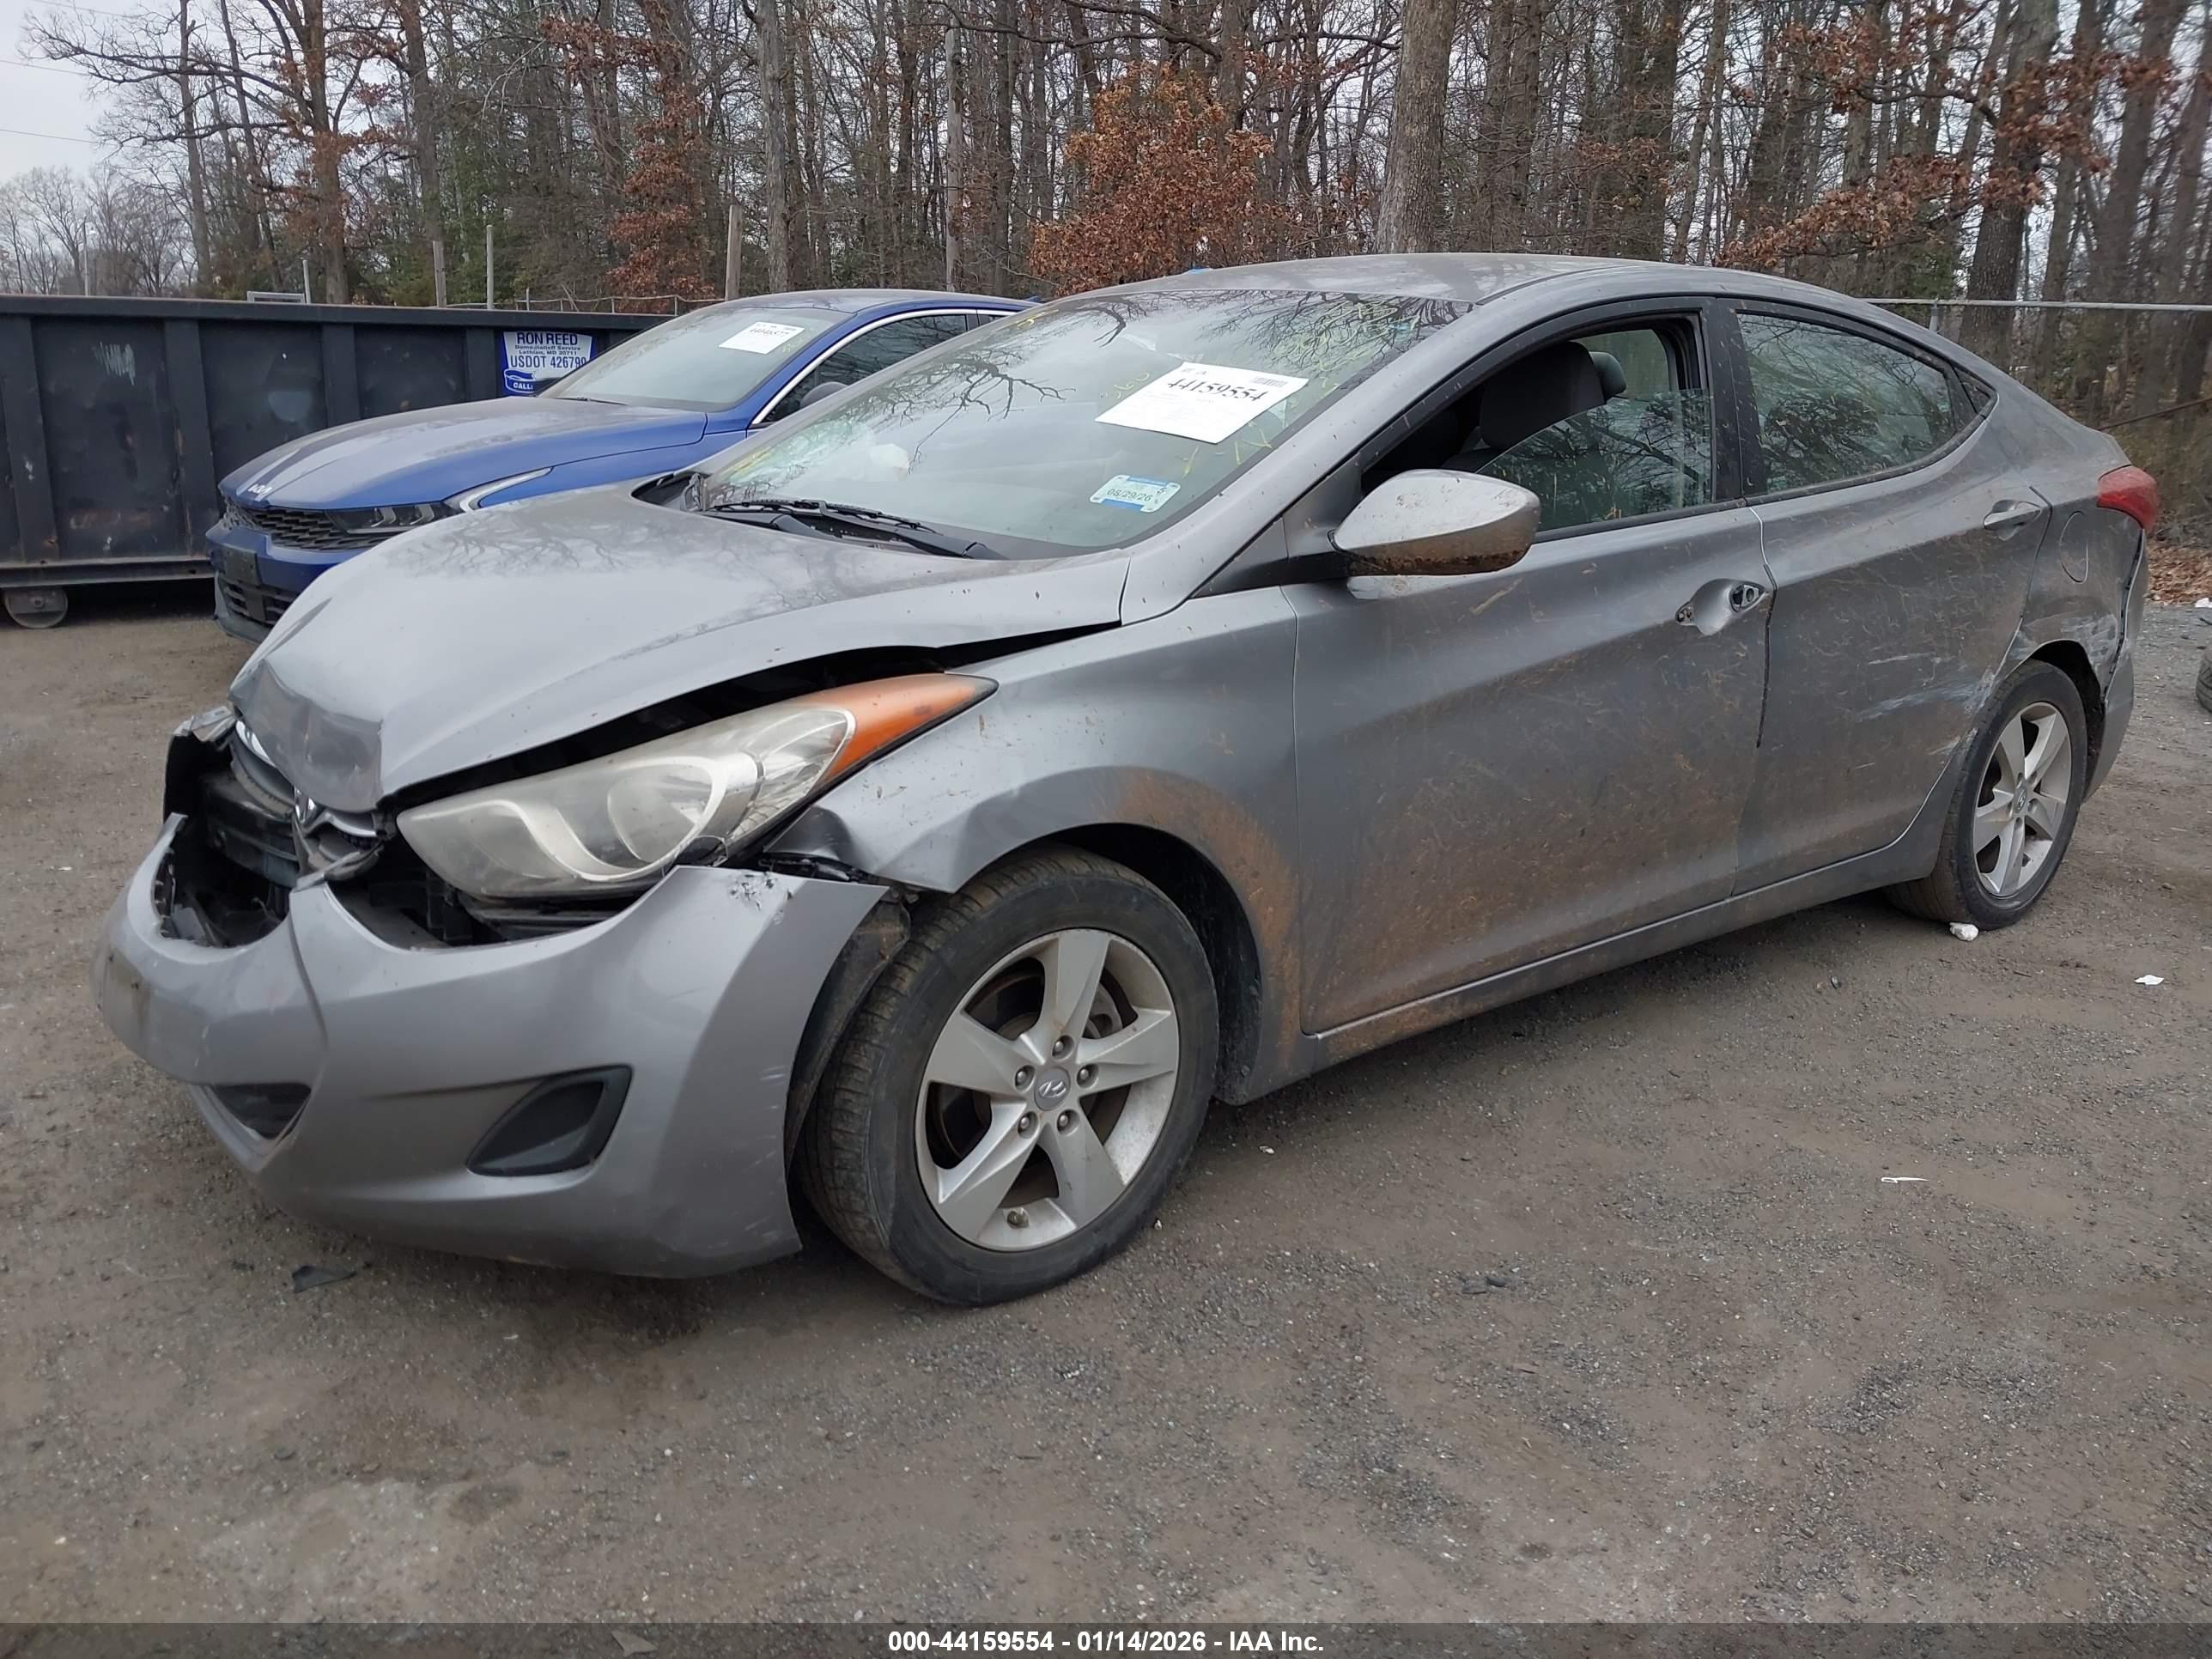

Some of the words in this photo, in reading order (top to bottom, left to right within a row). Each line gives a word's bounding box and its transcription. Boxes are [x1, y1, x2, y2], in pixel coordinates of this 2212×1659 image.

[517, 332, 543, 344] RON
[546, 333, 578, 345] REED
[510, 356, 546, 368] USDOT
[1168, 378, 1268, 401] 44159554
[1106, 488, 1153, 501] 08/29/26
